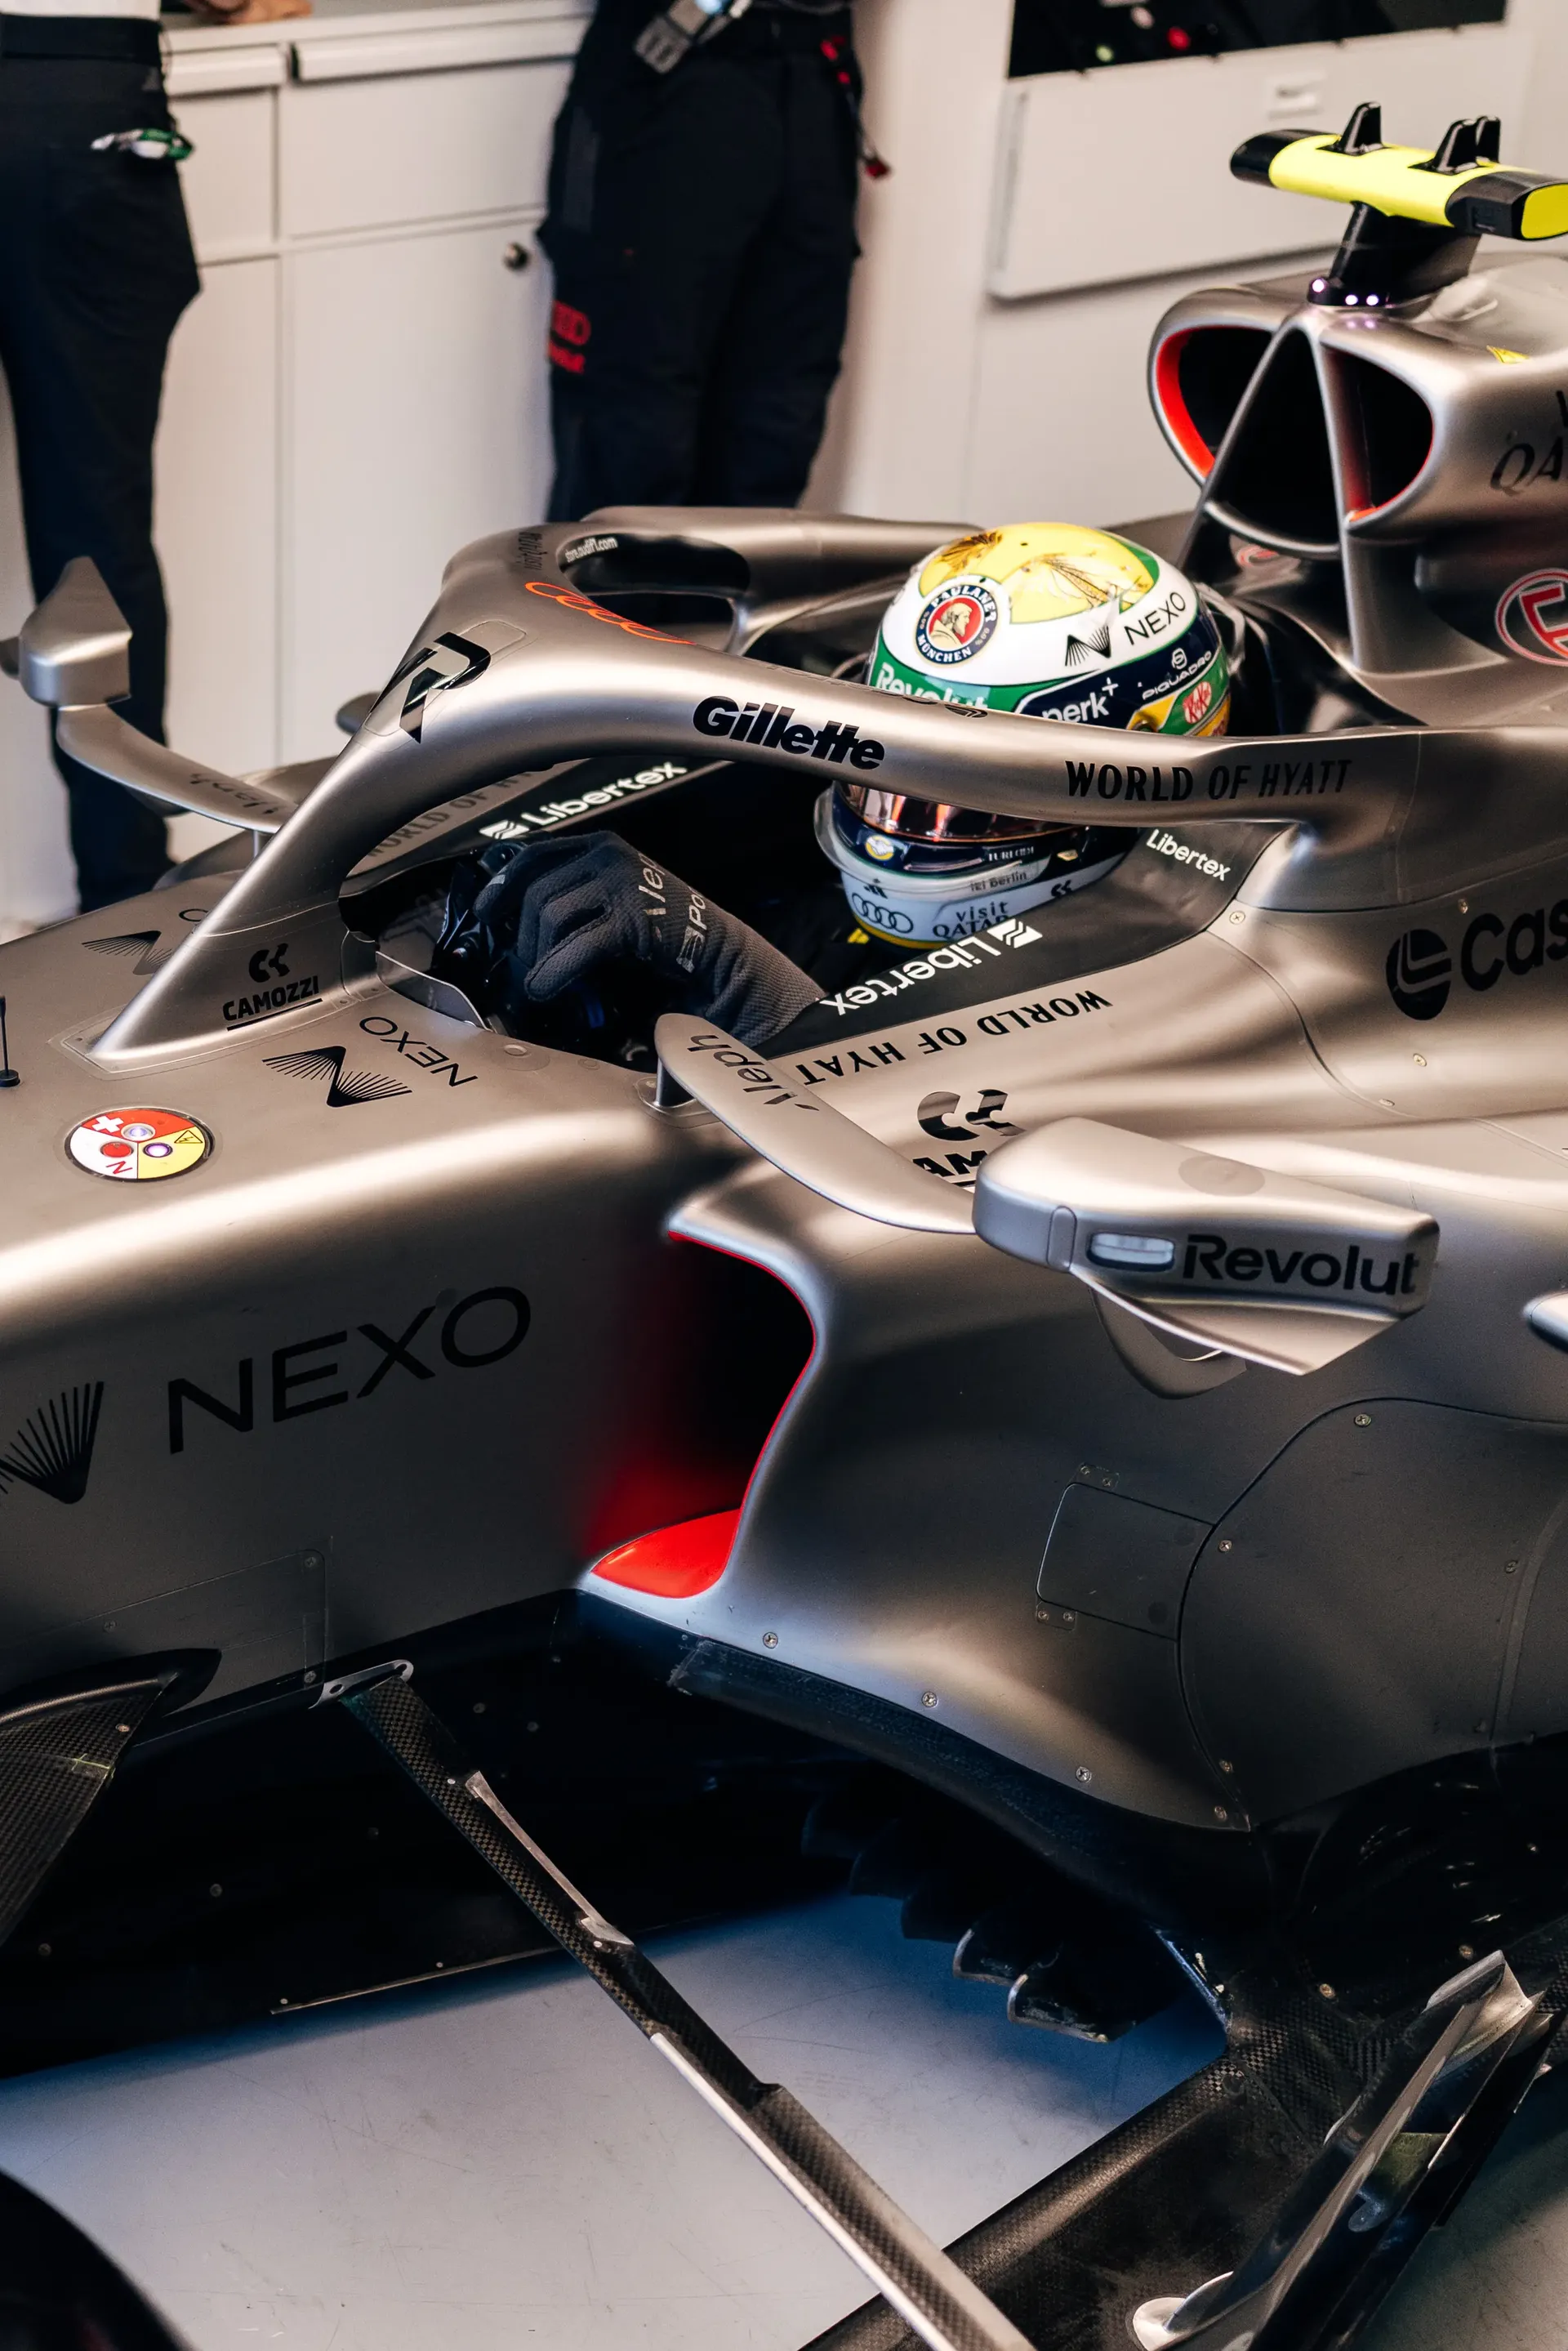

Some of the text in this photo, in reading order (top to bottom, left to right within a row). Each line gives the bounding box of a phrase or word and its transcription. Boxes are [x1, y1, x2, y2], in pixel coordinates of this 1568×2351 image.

[1490, 435, 1568, 497] QA
[930, 585, 996, 622] PAULANER
[1124, 591, 1186, 645] NEXO
[917, 634, 972, 662] MÜNCHEN
[1142, 651, 1212, 700] PIQUADRO
[693, 695, 885, 770] Gillette
[521, 761, 688, 827] Libertex
[1065, 759, 1352, 801] WORLD OF HYATT
[1146, 828, 1230, 881] Libertex
[222, 975, 319, 1021] CAMOZZI
[819, 936, 1001, 1015] Libertex
[359, 1016, 479, 1087] NEXO
[795, 990, 1113, 1086] WORLD OF HYAT
[1183, 1233, 1419, 1295] Revolut
[167, 1286, 531, 1455] NEXO
